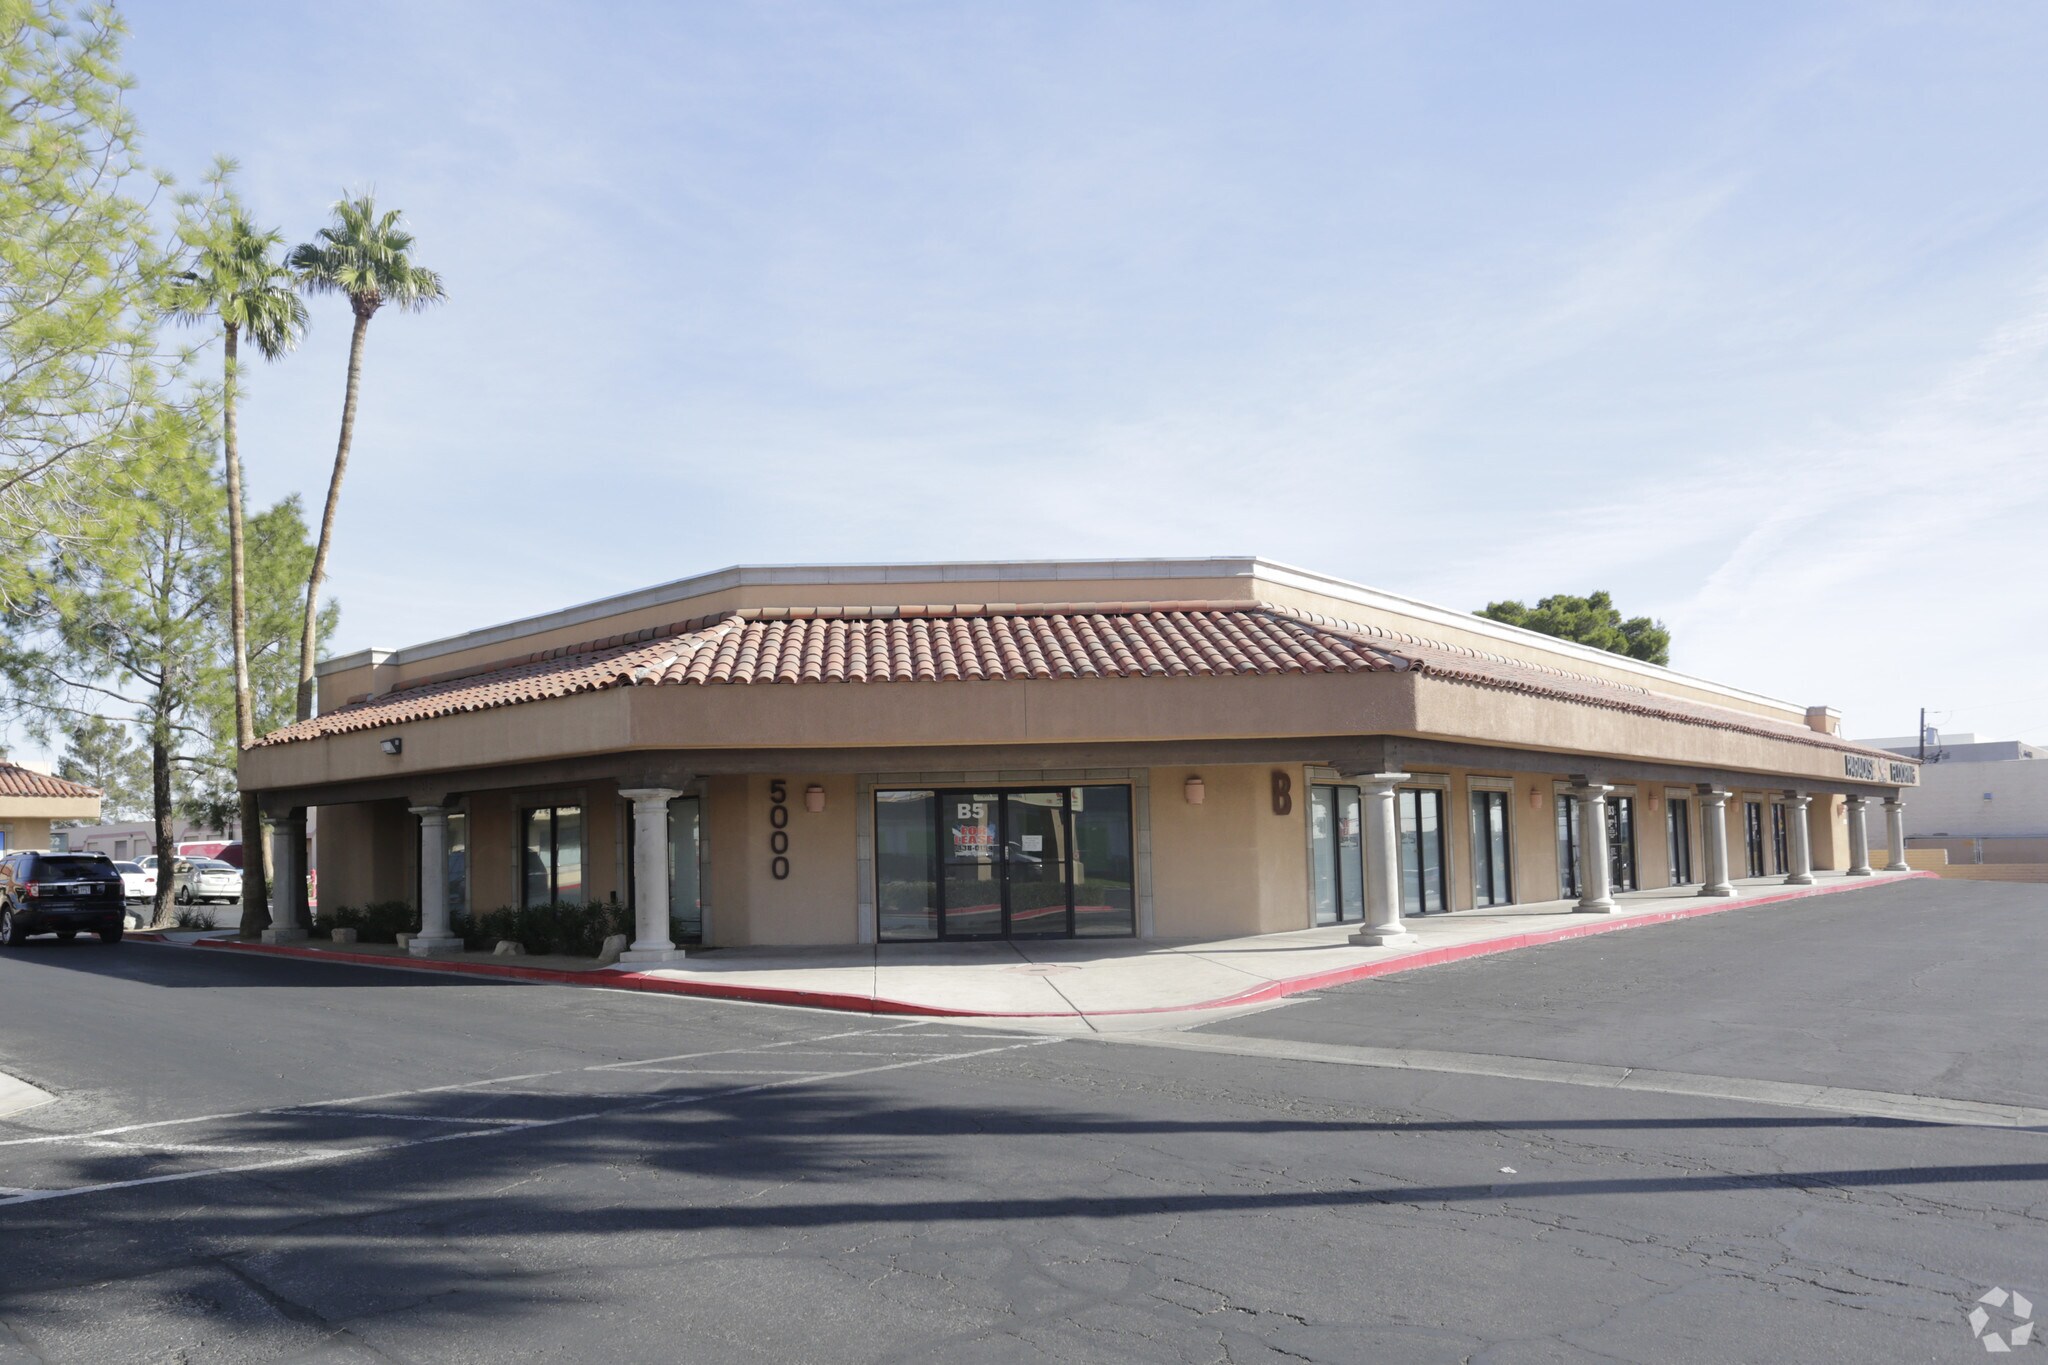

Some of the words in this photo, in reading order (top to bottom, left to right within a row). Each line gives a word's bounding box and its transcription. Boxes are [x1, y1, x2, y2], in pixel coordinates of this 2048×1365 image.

[1271, 769, 1292, 816] B
[957, 803, 985, 819] B5
[769, 780, 790, 880] 5000
[961, 825, 987, 835] FOR
[954, 835, 993, 845] LEASE
